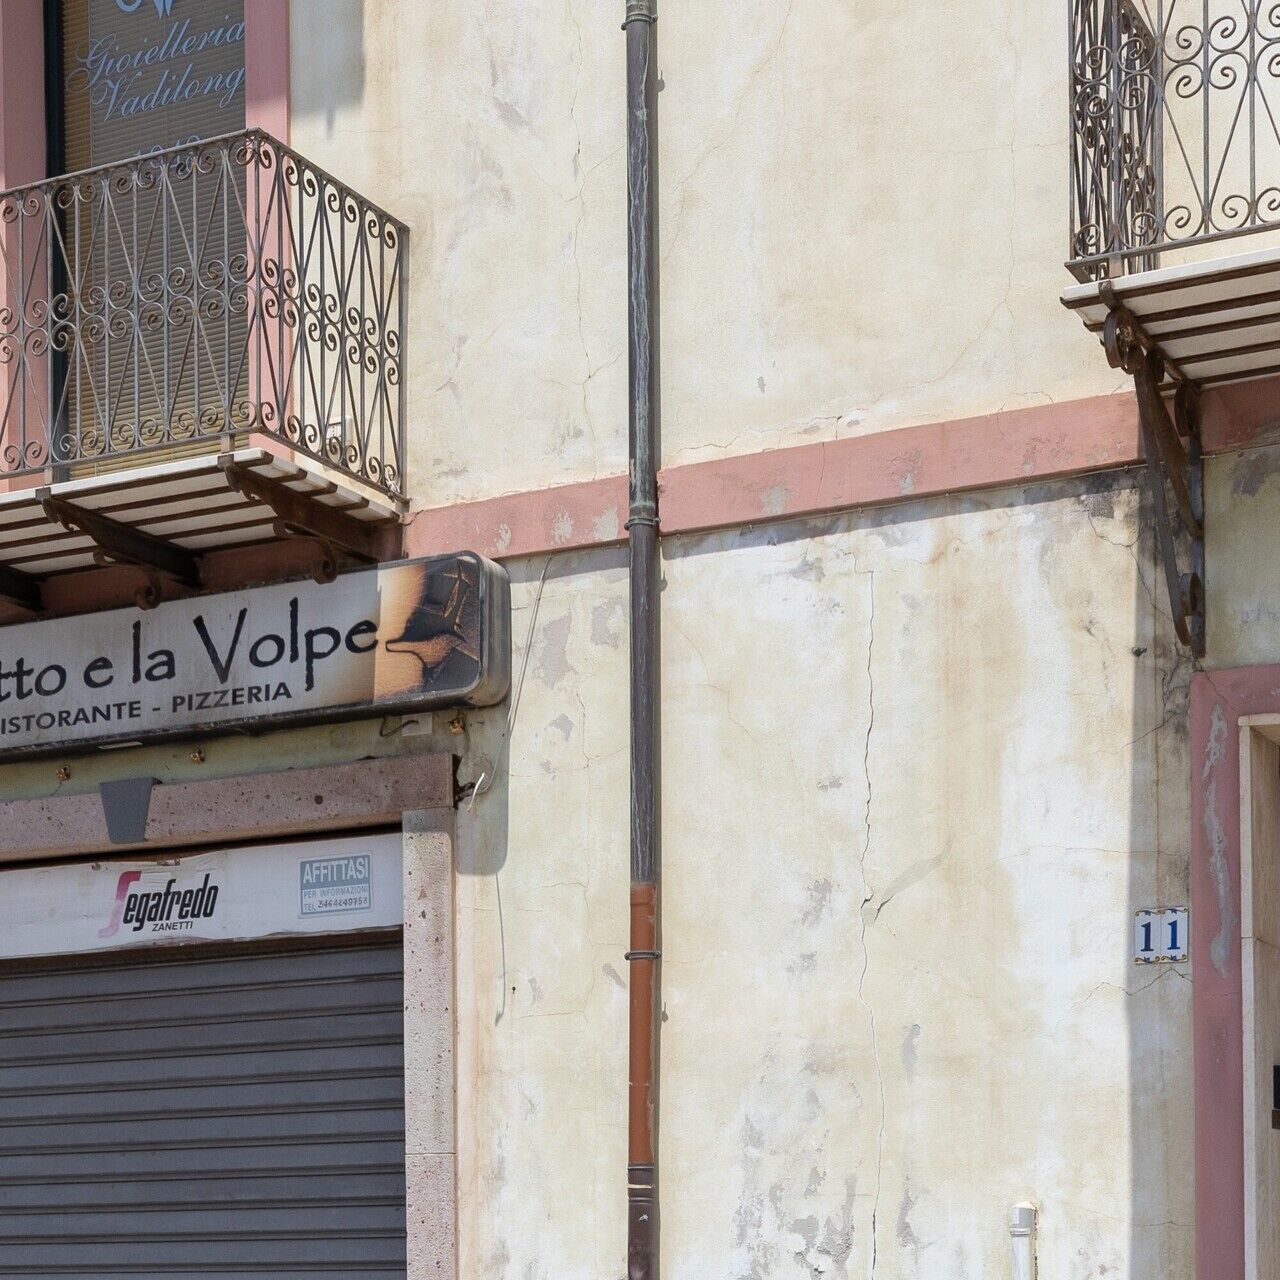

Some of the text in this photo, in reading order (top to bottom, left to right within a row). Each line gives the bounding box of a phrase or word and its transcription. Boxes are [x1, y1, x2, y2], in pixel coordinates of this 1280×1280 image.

[83, 656, 114, 689] e
[132, 620, 176, 684] la
[193, 597, 379, 692] Volpe
[172, 682, 293, 713] PIZZERIA
[303, 857, 368, 884] AFFITTASI
[303, 890, 317, 900] PER
[152, 921, 193, 932] ZANETTI
[1140, 920, 1181, 952] 11
